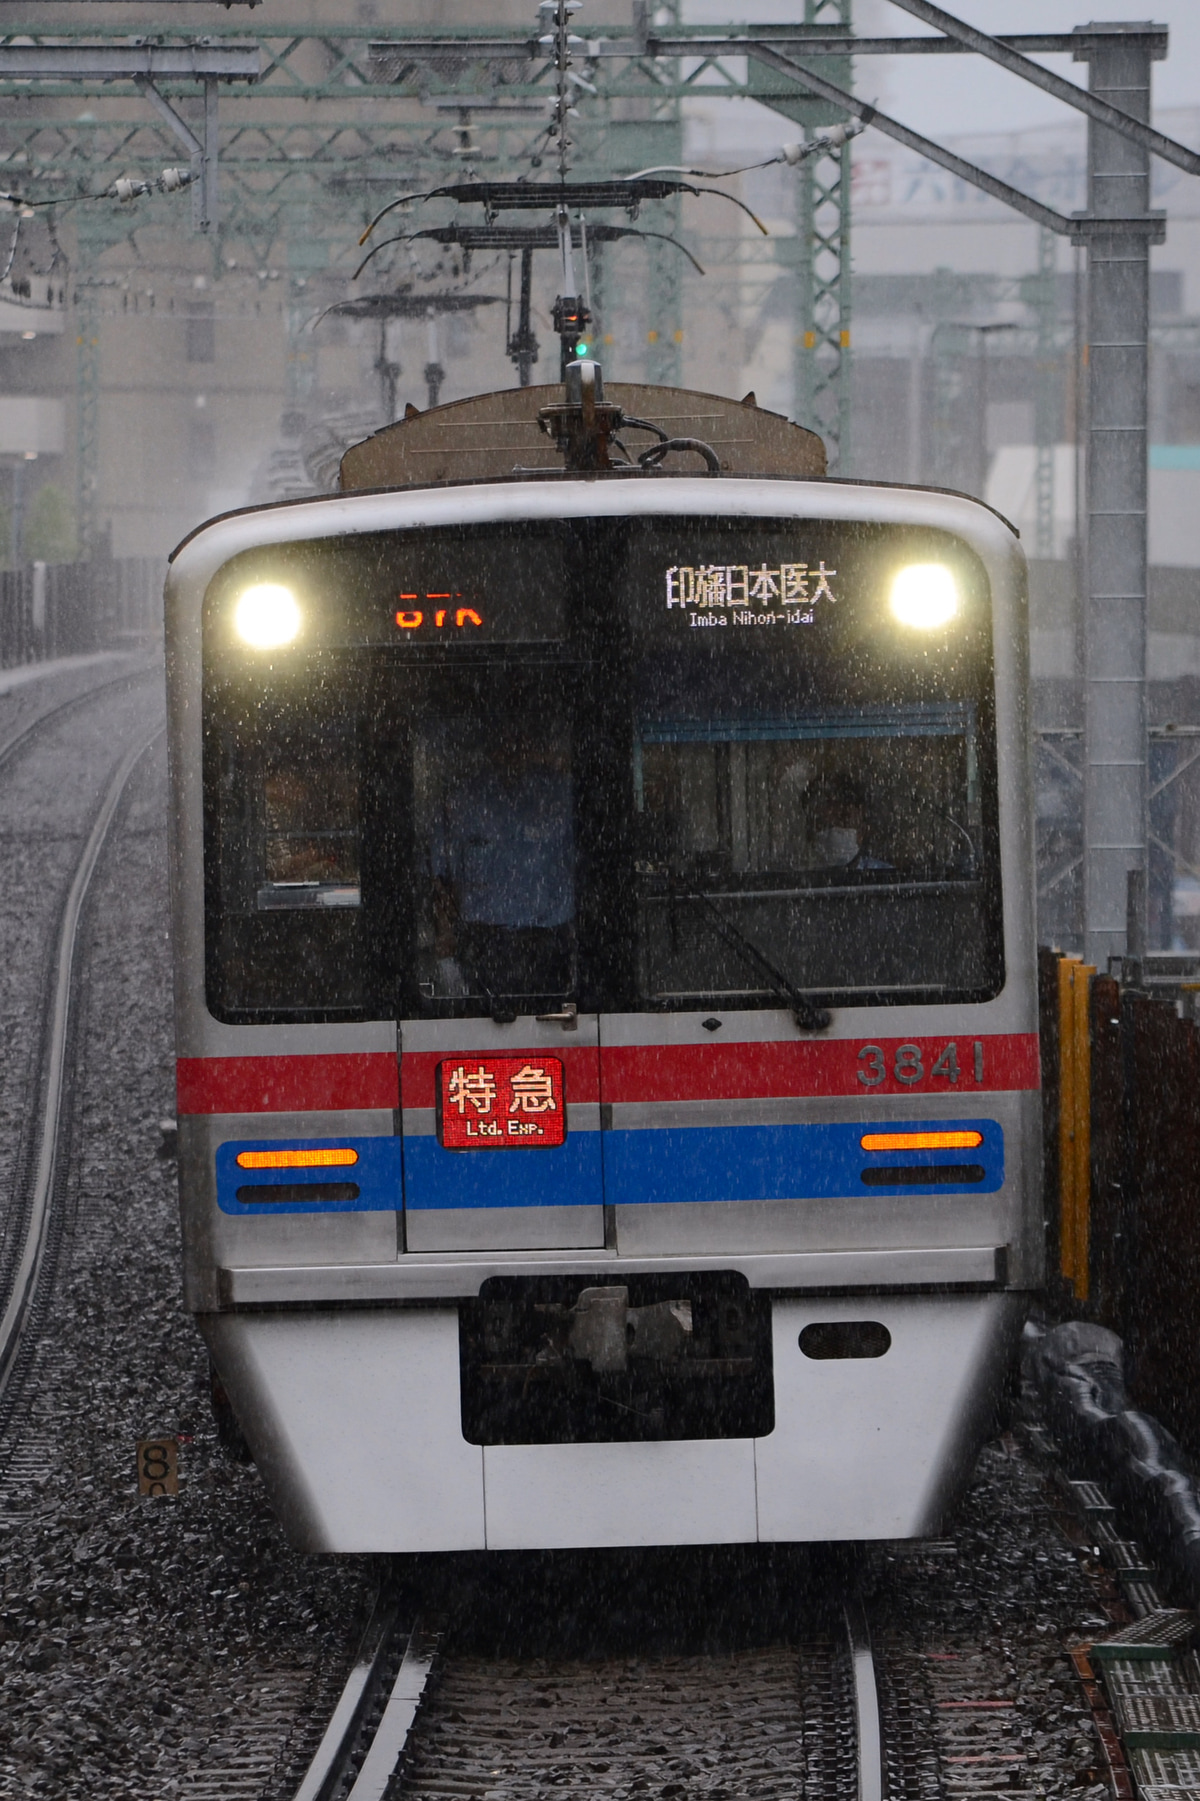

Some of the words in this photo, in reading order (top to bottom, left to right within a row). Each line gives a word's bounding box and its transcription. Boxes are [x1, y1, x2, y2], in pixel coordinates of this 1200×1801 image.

[666, 561, 837, 609] 印旛日本医大
[690, 612, 728, 627] Imba
[733, 609, 814, 626] Nihon-idai
[857, 1041, 984, 1086] 3841
[449, 1065, 556, 1113] 特急
[466, 1120, 503, 1136] Ltd.
[143, 1445, 170, 1480] 8
